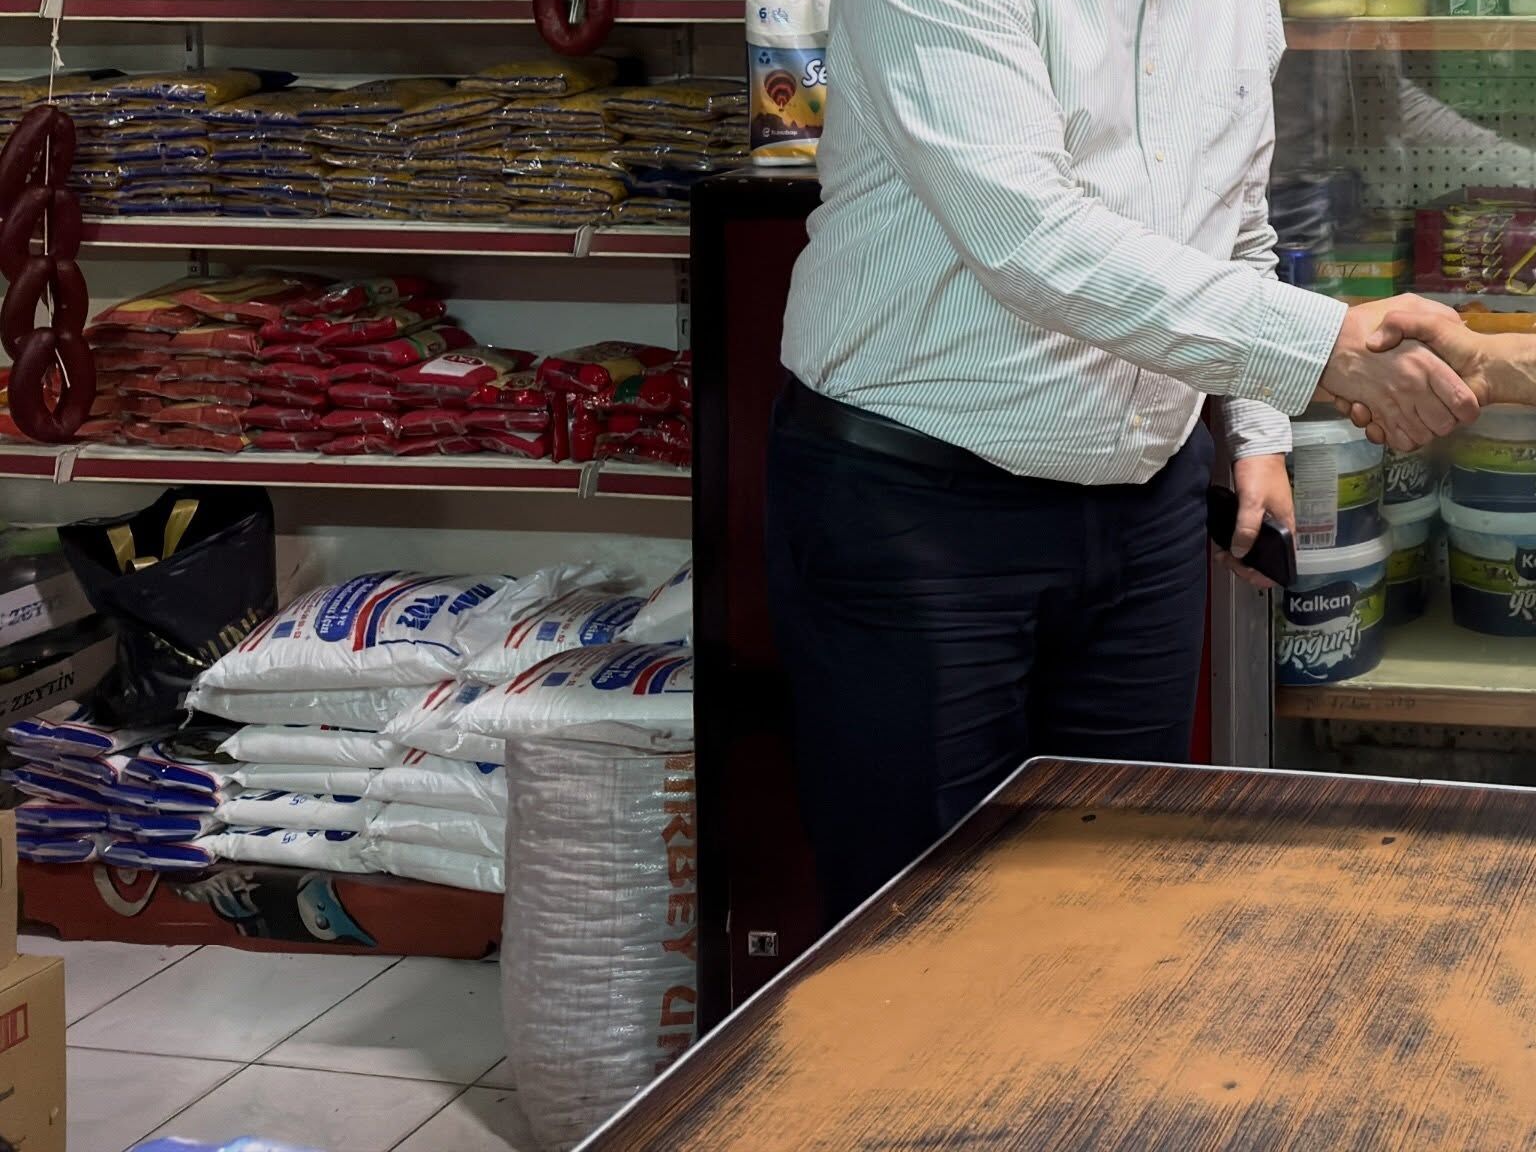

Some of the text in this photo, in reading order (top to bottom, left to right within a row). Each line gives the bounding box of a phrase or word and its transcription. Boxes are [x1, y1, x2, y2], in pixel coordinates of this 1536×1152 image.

[759, 8, 767, 19] 6
[1290, 594, 1351, 613] Kalkan
[1278, 613, 1362, 665] yoğurt
[11, 671, 75, 712] ZEYTİN
